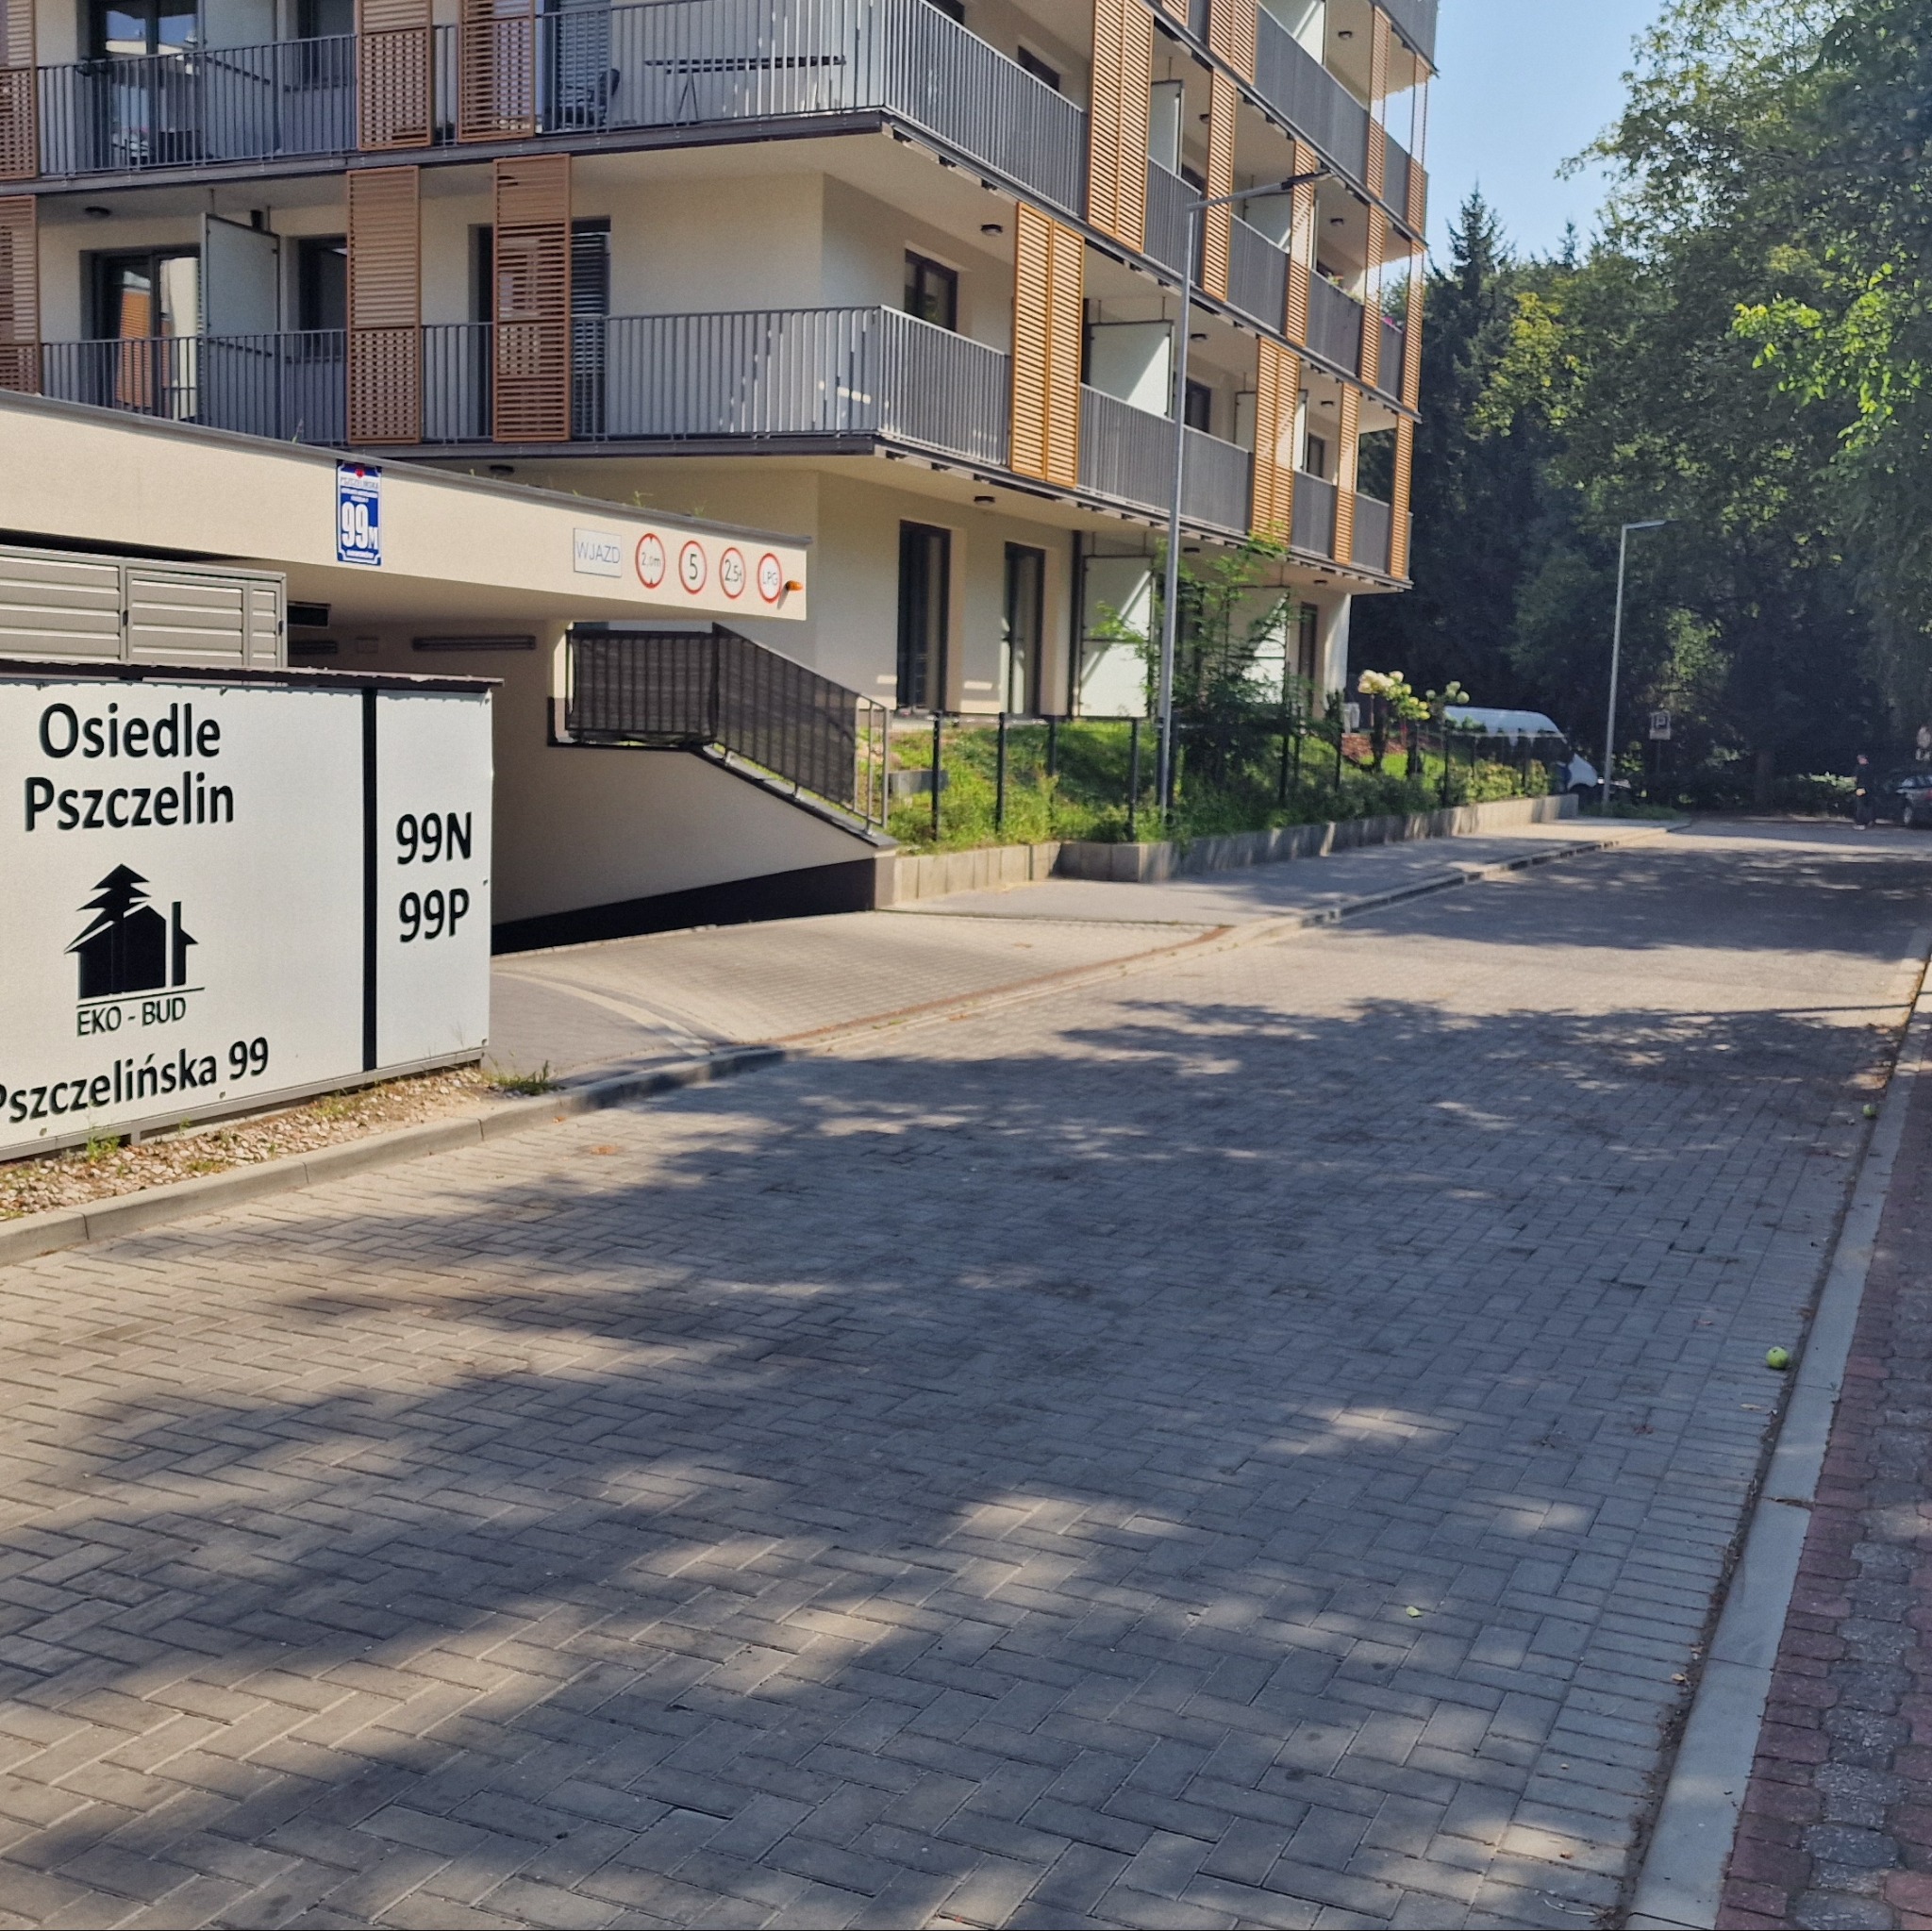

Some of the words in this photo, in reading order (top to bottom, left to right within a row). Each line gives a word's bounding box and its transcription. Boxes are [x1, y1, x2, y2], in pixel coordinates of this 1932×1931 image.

[341, 501, 378, 550] 99M
[575, 541, 621, 564] WJAZD
[689, 553, 698, 580] 5
[762, 570, 778, 586] LPG
[39, 702, 221, 758] Osiedle
[25, 770, 234, 832] Pszczelin
[396, 811, 472, 865] 99N
[399, 888, 470, 943] 99P
[76, 1006, 123, 1037] EKO
[142, 996, 187, 1027] BUD
[228, 1036, 269, 1081] 99
